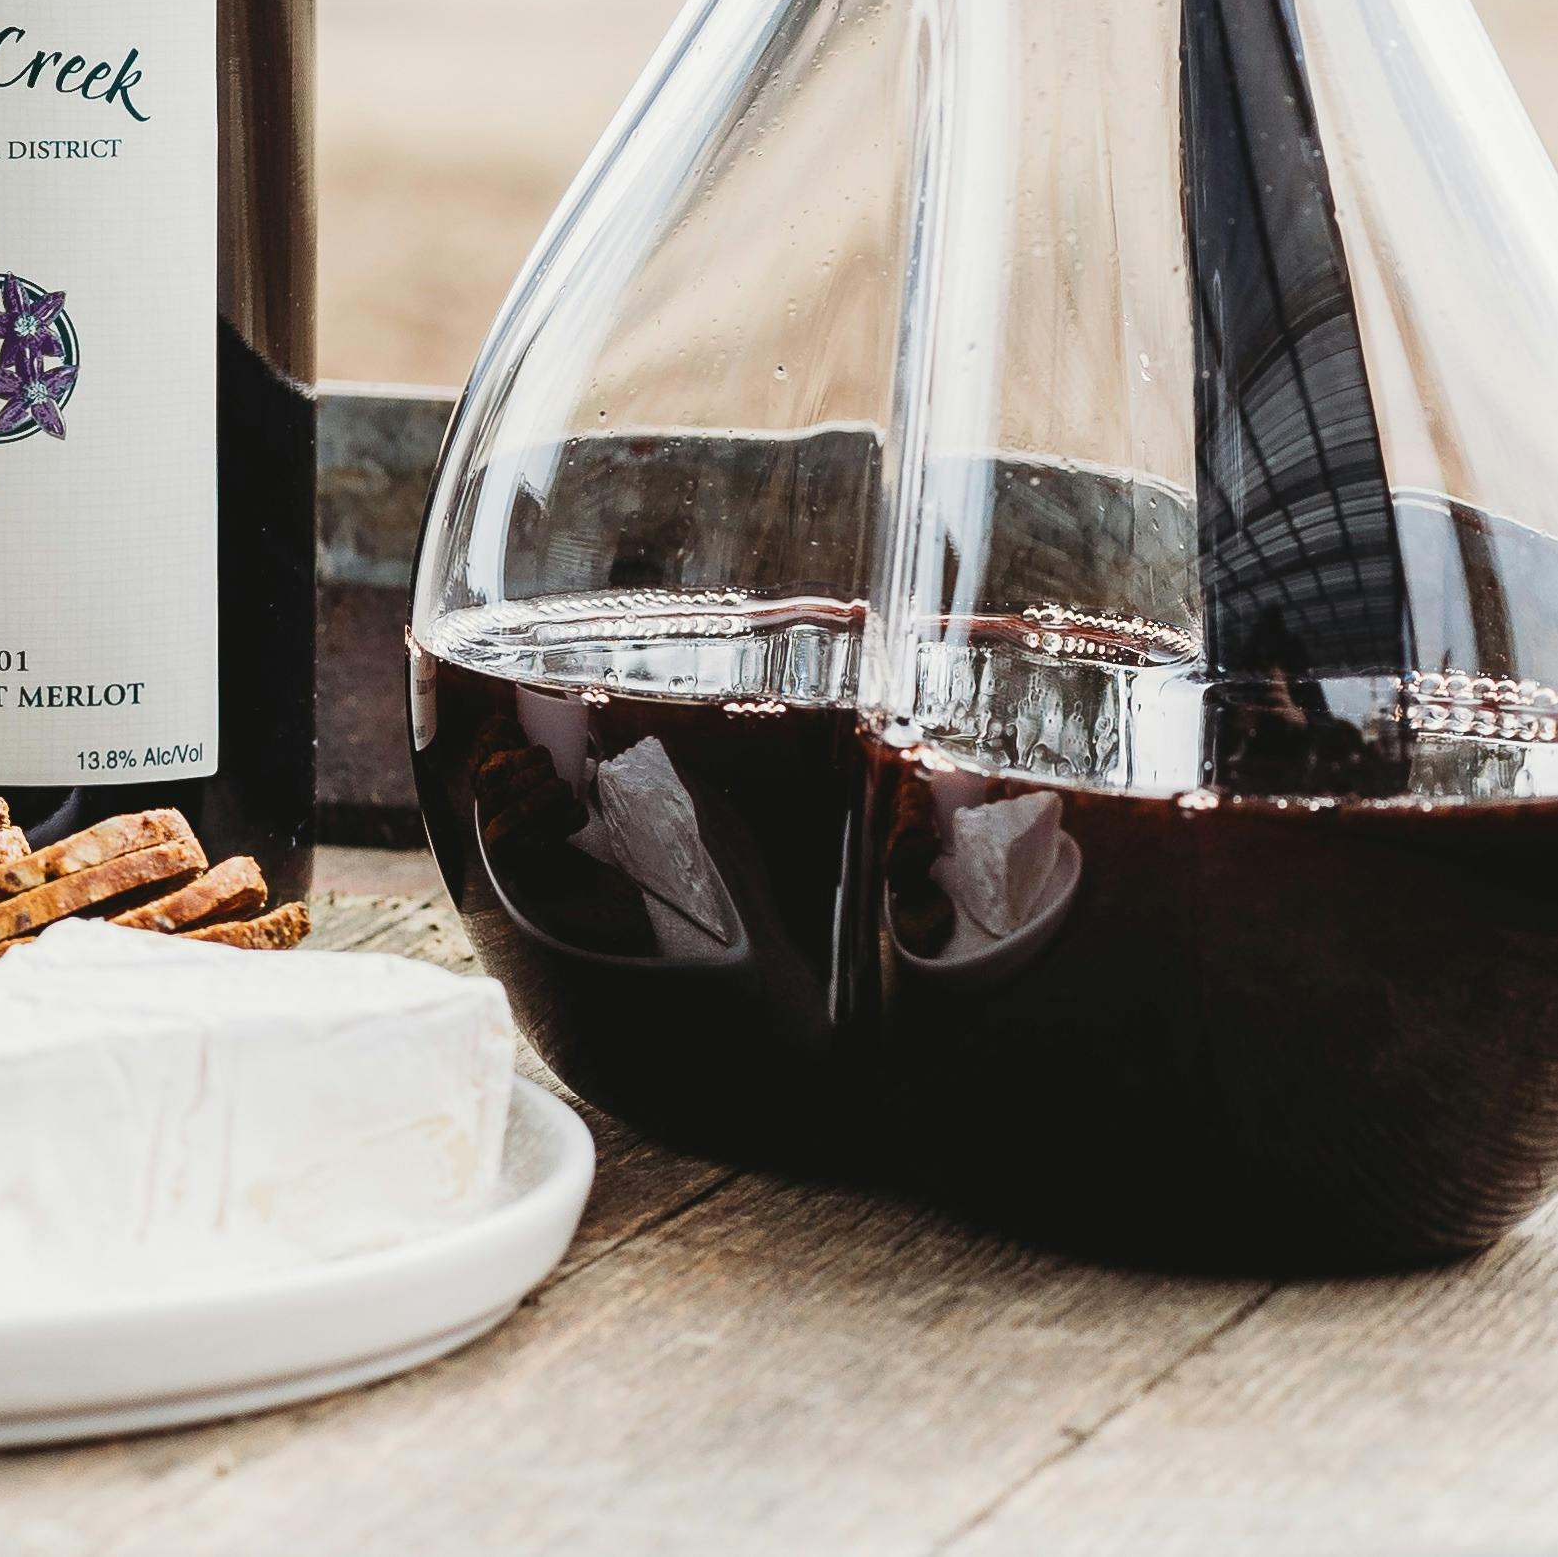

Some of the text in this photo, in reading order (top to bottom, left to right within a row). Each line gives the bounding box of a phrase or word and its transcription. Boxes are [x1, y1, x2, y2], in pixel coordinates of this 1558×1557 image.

[7, 138, 123, 161] DISTRICT
[17, 681, 146, 709] MERLOT
[77, 742, 204, 771] 13.8% Alc/Vol
